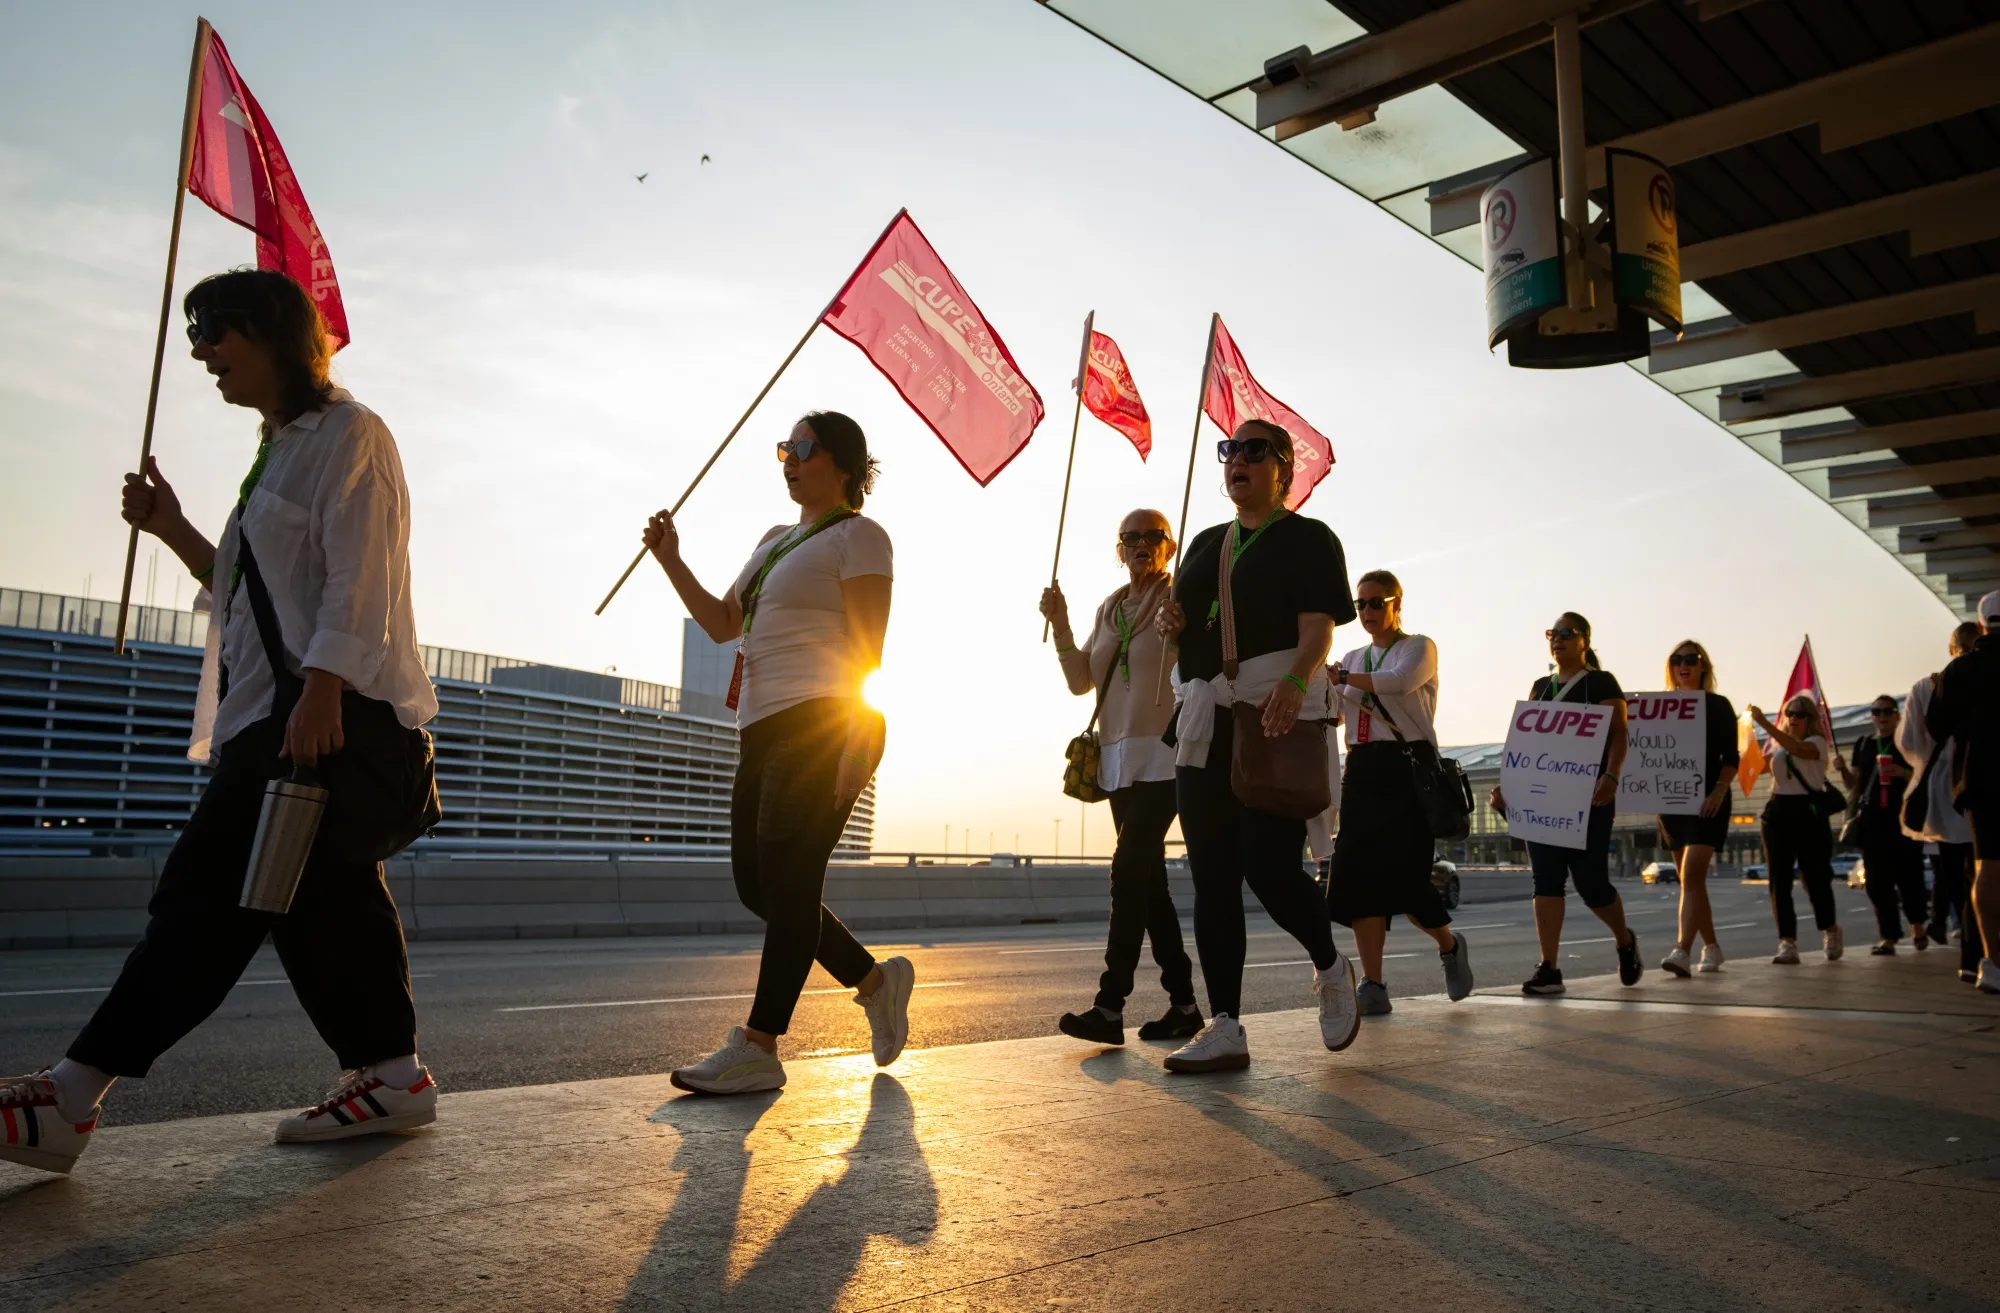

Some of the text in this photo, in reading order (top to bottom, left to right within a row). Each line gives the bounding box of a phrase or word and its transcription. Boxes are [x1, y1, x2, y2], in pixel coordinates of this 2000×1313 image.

[913, 276, 978, 334] CUPE
[893, 332, 909, 347] FOR
[900, 324, 935, 359] FIGHTING
[885, 338, 920, 373] FAIRNESS
[935, 374, 953, 393] POUR
[942, 365, 967, 394] LUTTER
[981, 371, 1018, 412] Ontario
[1626, 698, 1698, 720] CUPE
[1516, 709, 1604, 737] CUPE
[1627, 727, 1676, 749] WOULD
[1536, 753, 1600, 777] CONTRACT
[1664, 752, 1698, 772] WORK
[1622, 773, 1703, 797] FOR FREE?
